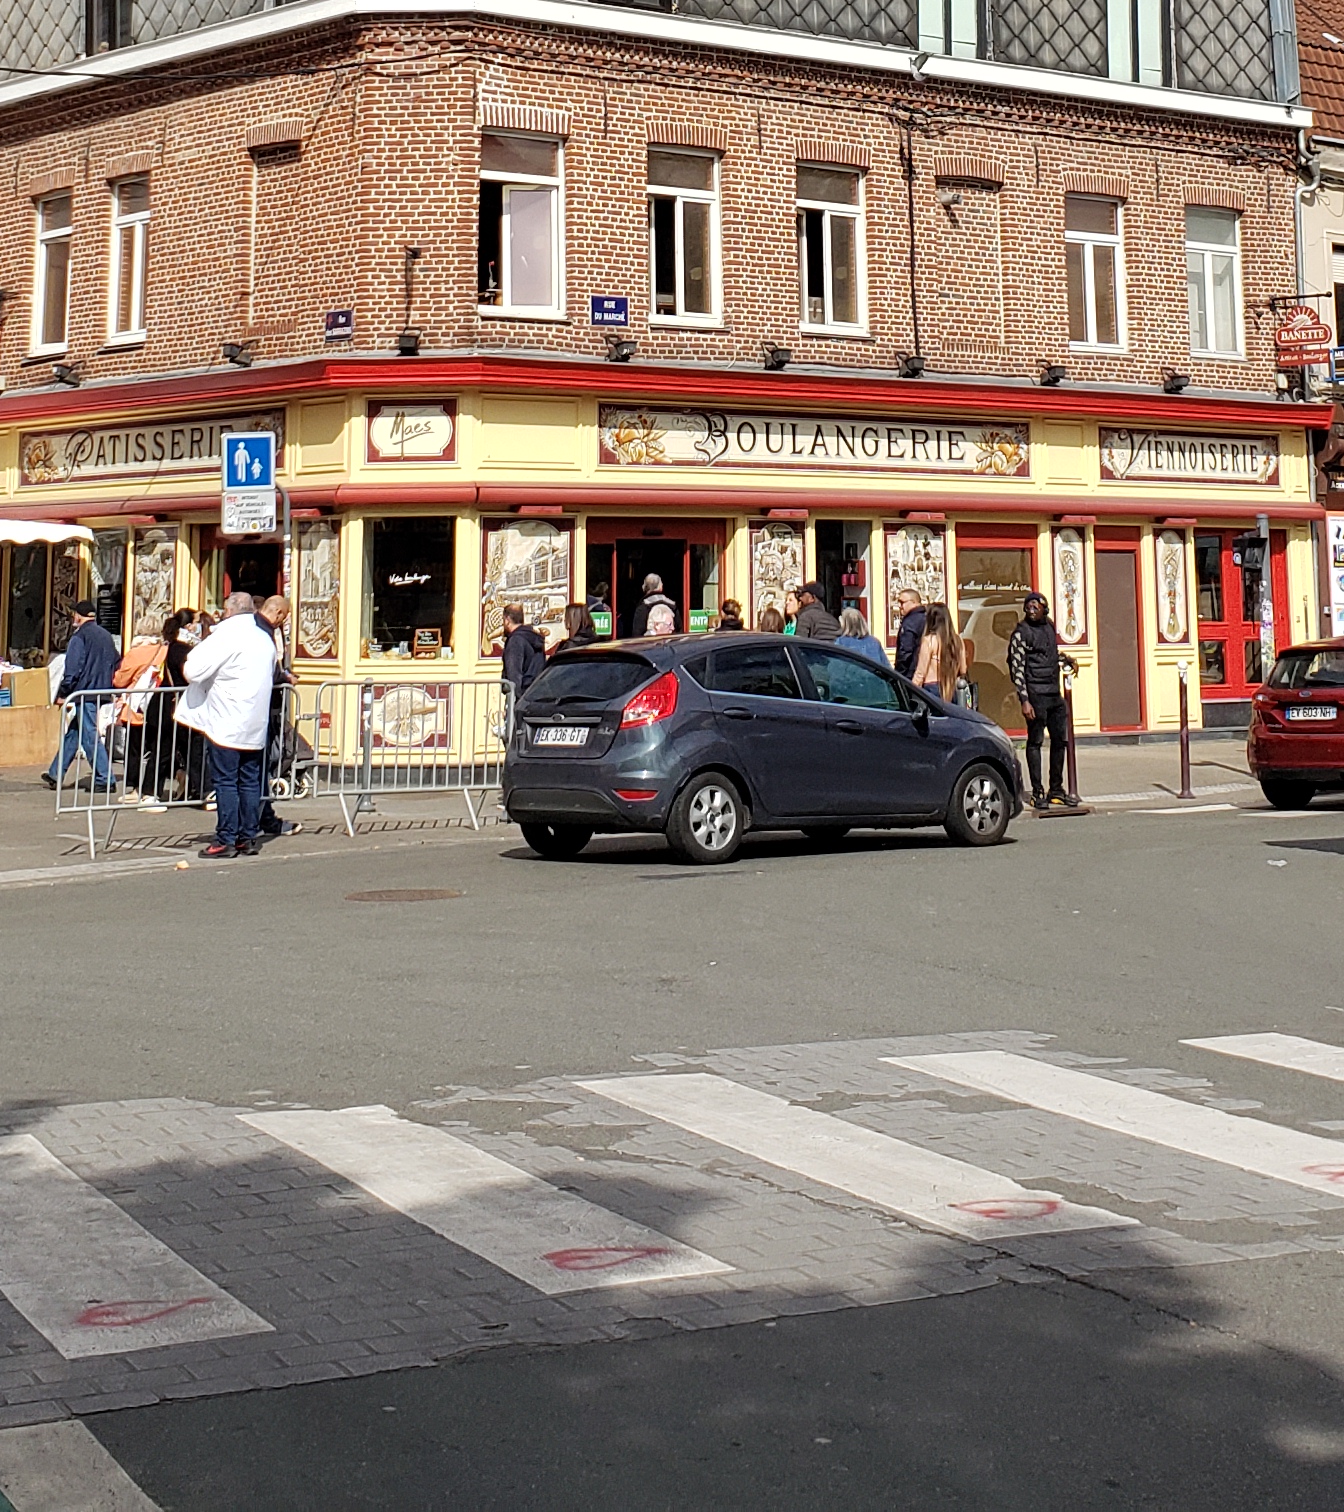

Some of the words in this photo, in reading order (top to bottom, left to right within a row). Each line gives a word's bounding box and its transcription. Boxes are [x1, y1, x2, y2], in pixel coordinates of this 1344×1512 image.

[1280, 329, 1326, 341] BANETTE
[389, 410, 434, 451] Maes
[1117, 429, 1259, 479] VIENNOISERIE
